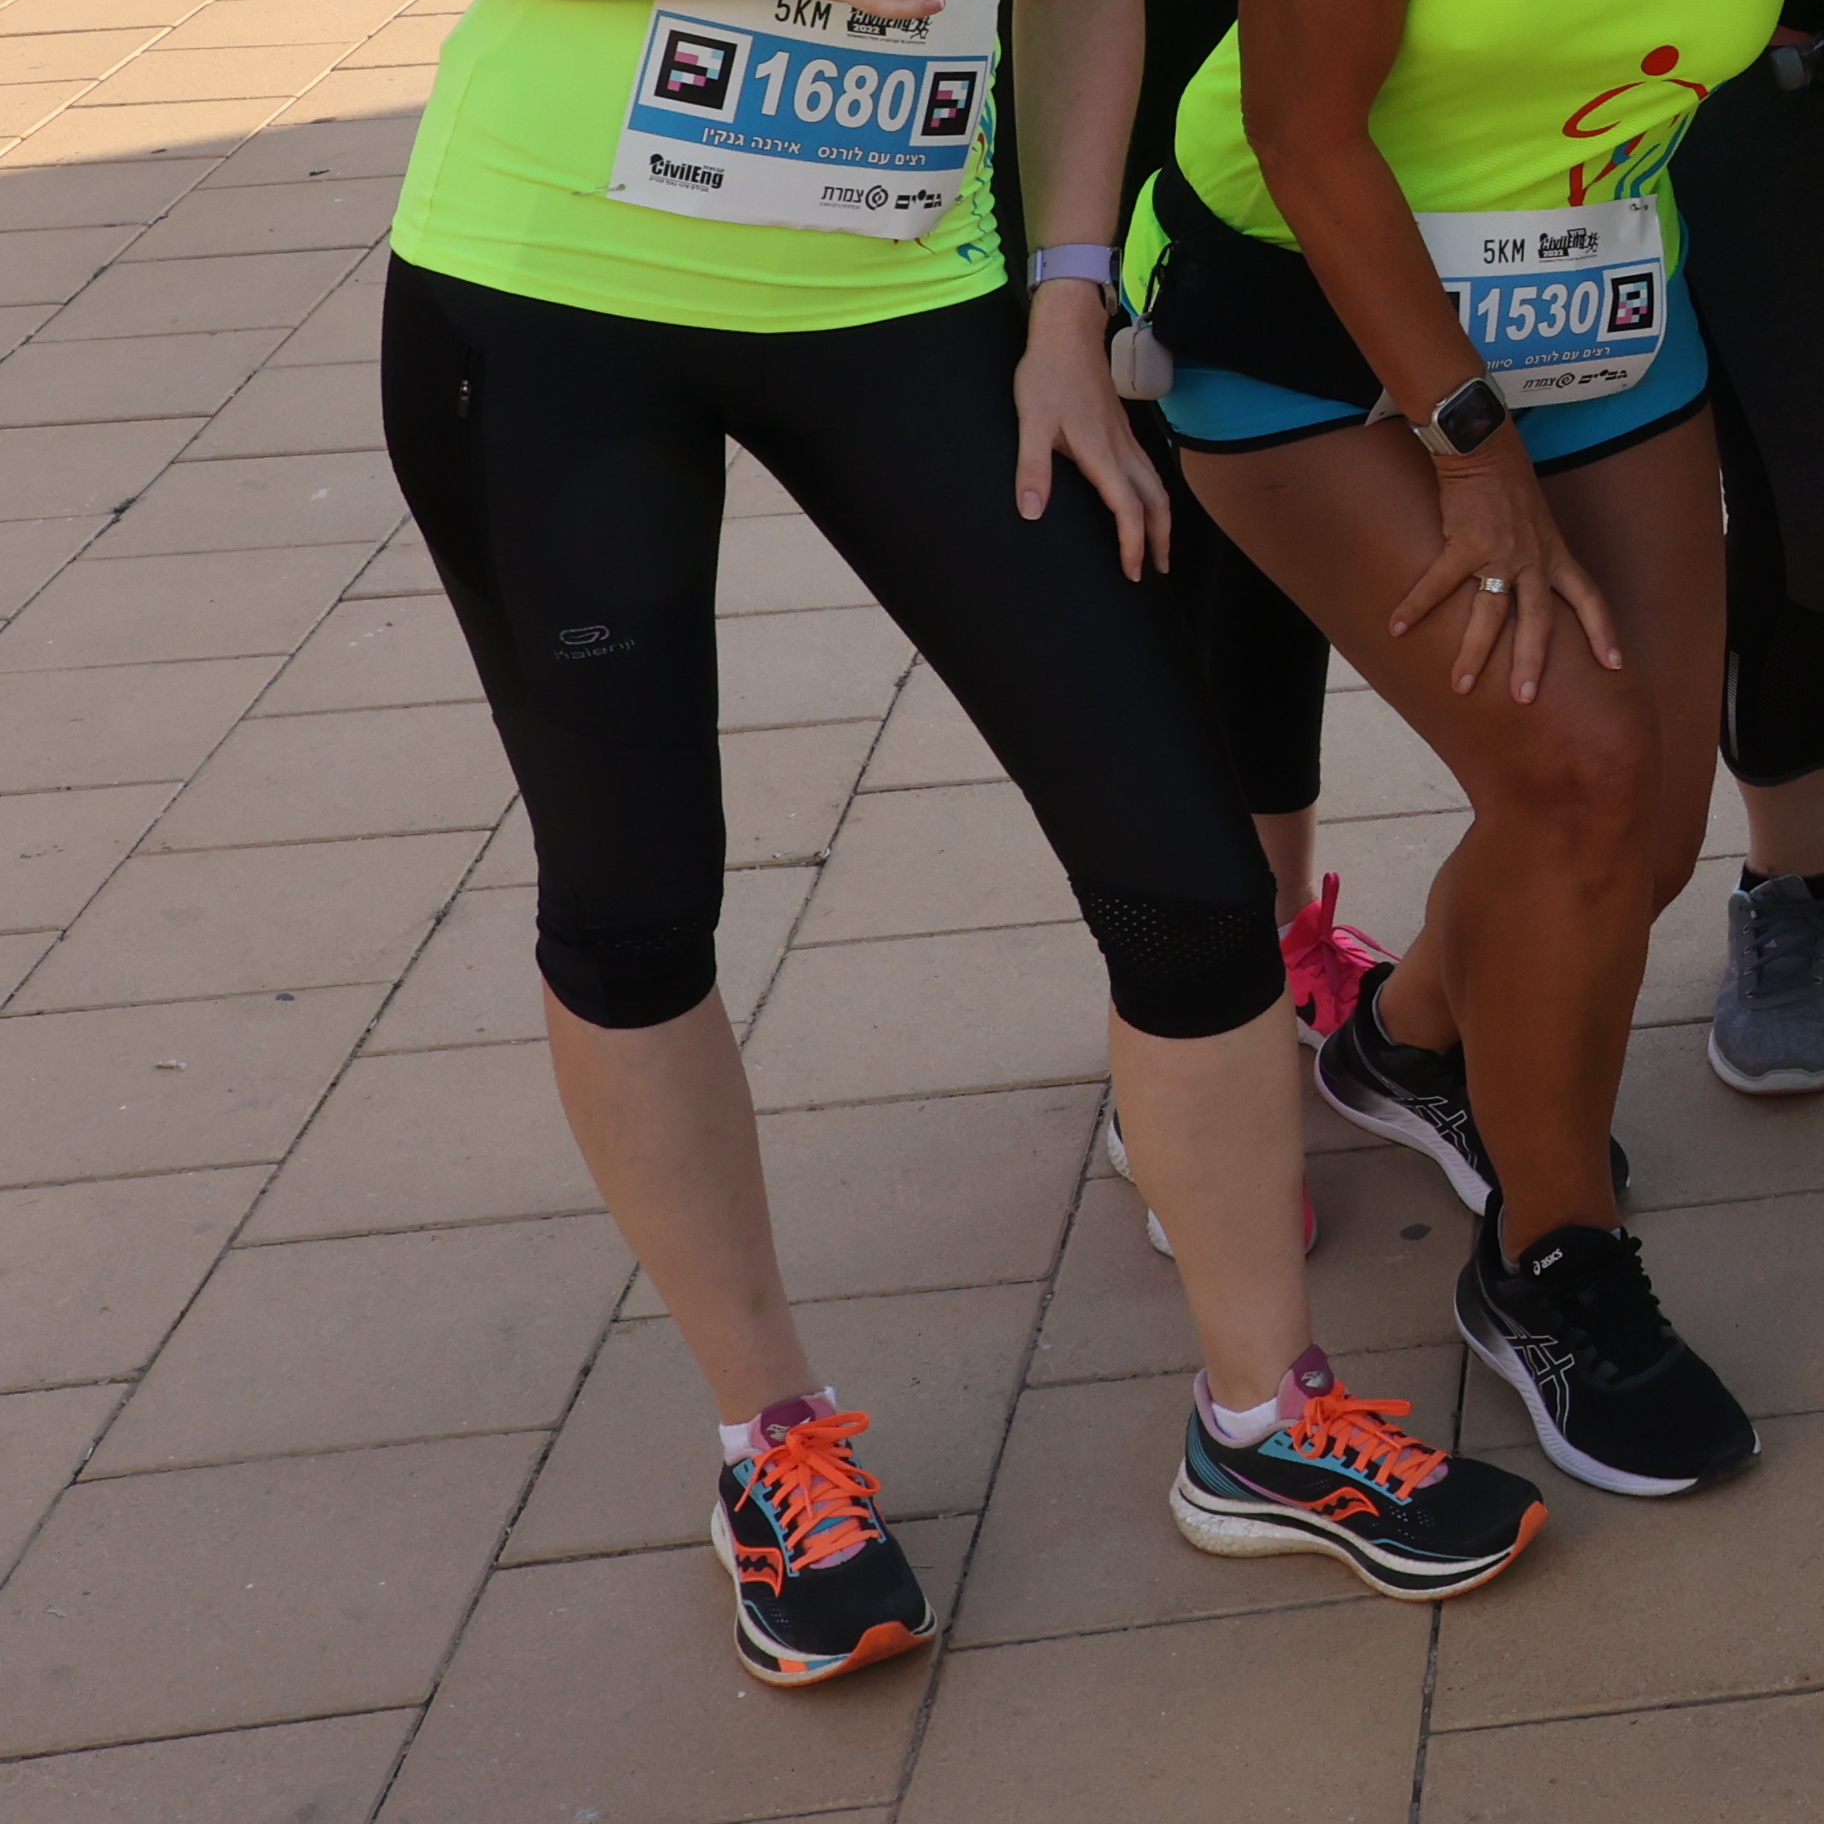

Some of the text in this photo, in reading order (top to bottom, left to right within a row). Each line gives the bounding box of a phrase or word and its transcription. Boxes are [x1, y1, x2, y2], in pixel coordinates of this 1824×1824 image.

[852, 22, 881, 35] 2022
[753, 50, 916, 132] 1680
[700, 127, 927, 166] רצים עם לורנס אירנה גנקין
[649, 155, 725, 190] CivilEng
[820, 184, 864, 204] צמרת
[1482, 237, 1526, 265] 5KM
[1542, 248, 1565, 258] 2022
[1477, 280, 1600, 344] 1530
[1524, 346, 1612, 367] רצים עם לורנס
[1521, 376, 1557, 392] צמרת
[553, 637, 636, 662] Kalenji
[1540, 1248, 1564, 1270] asics
